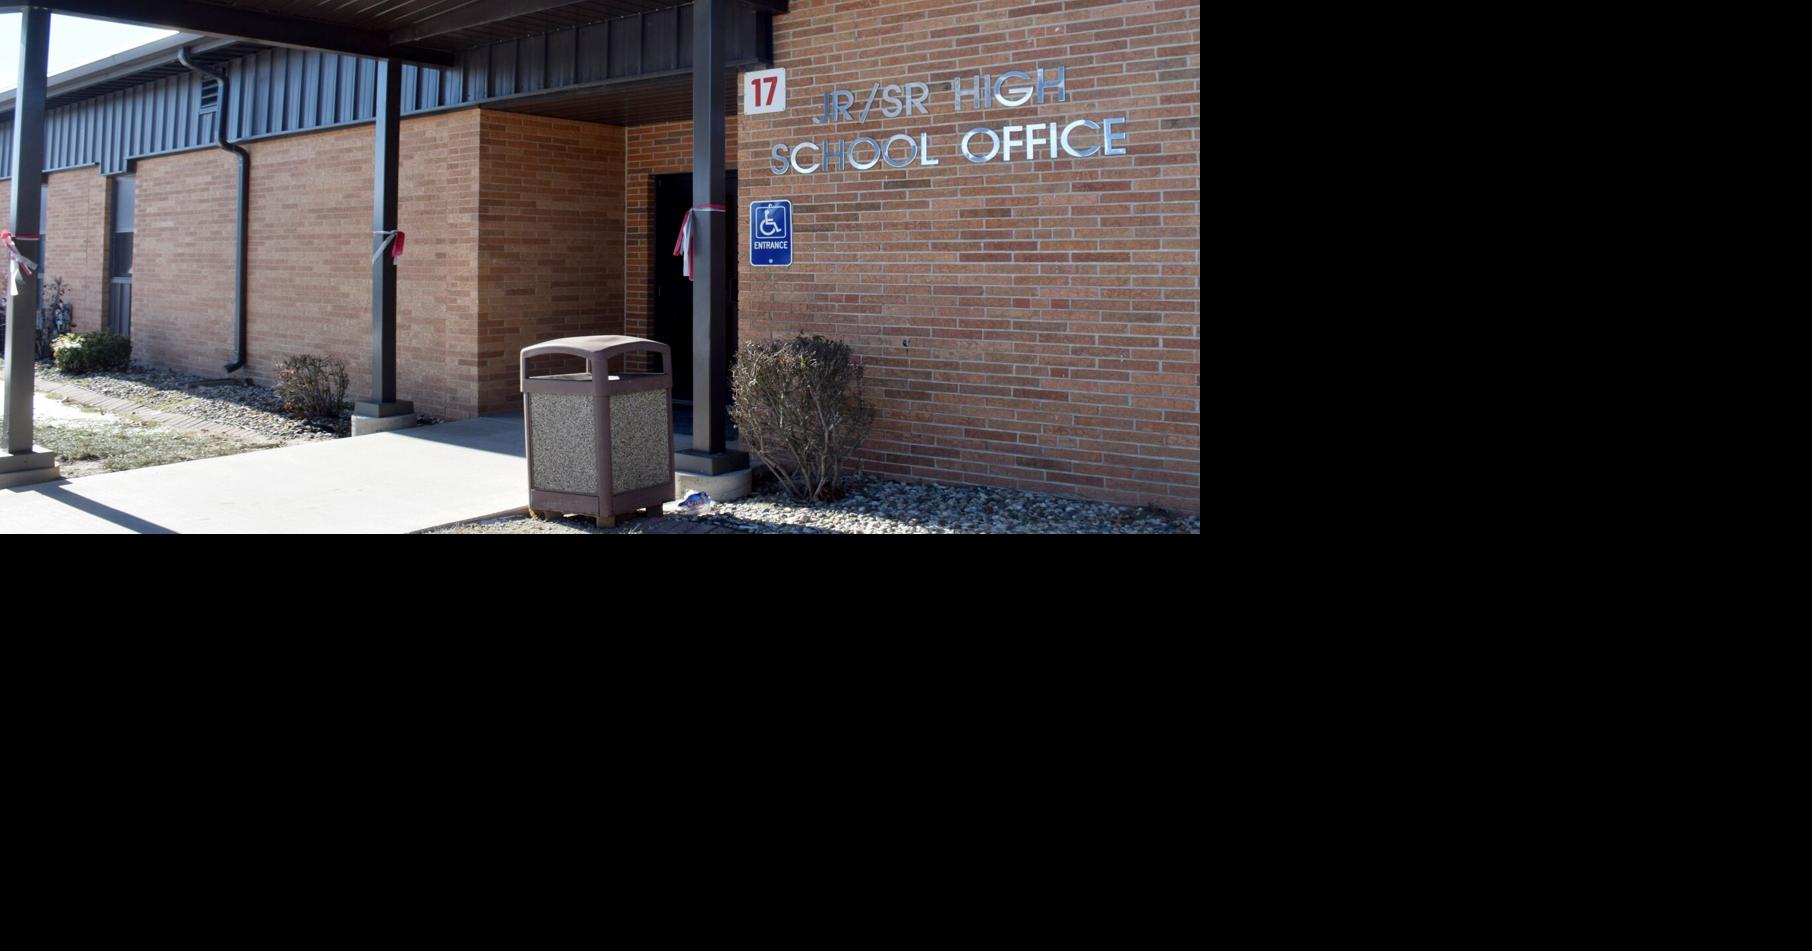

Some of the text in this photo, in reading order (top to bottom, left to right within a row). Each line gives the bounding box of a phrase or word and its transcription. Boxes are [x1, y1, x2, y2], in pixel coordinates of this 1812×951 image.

[751, 76, 778, 107] 17
[812, 65, 1067, 124] JR/SR HIGH
[769, 116, 1127, 175] SCHOOL OFFICE
[754, 241, 788, 250] ENTRANCE
